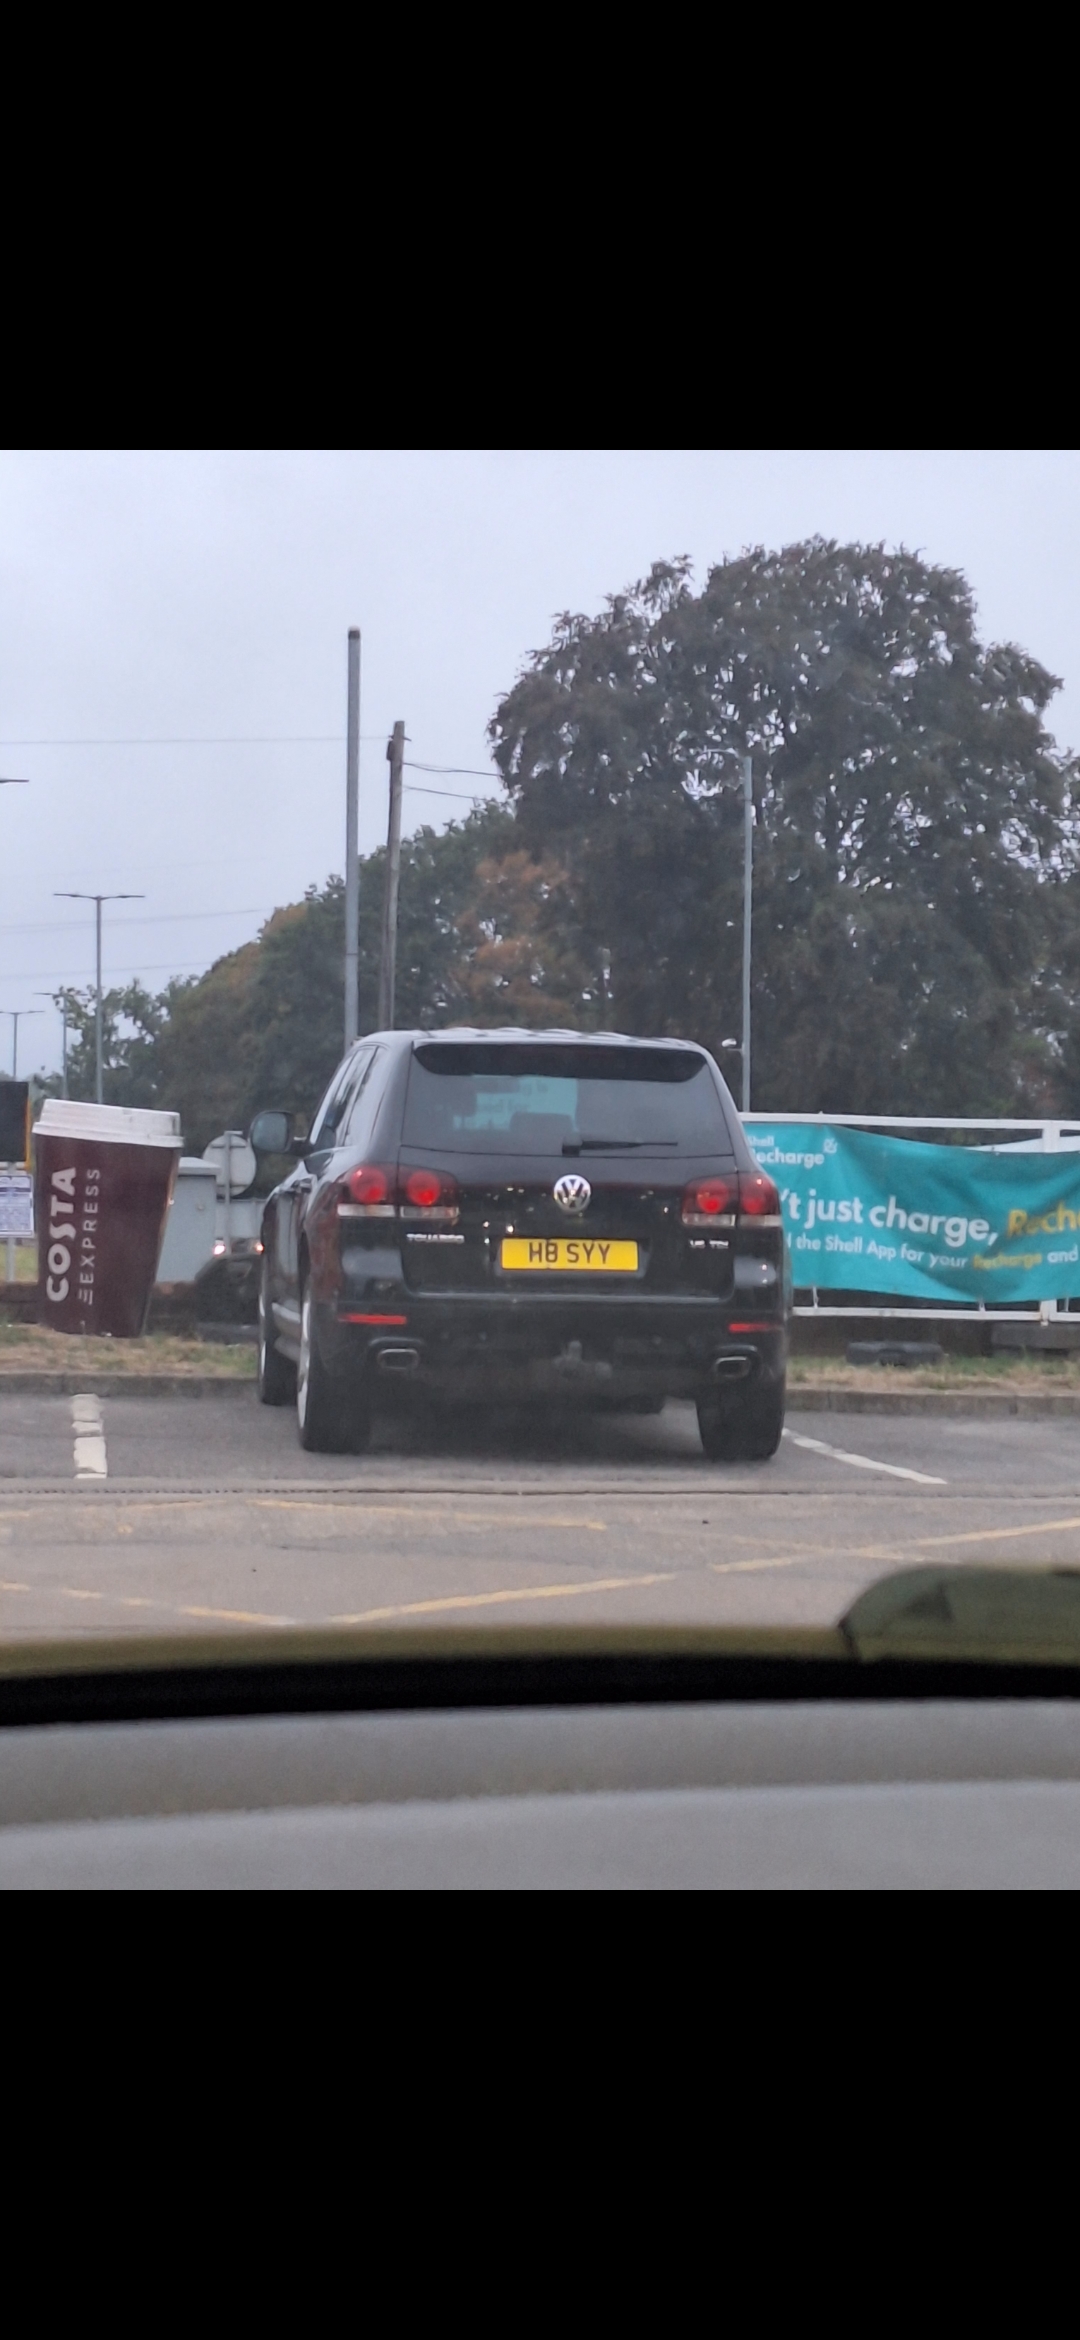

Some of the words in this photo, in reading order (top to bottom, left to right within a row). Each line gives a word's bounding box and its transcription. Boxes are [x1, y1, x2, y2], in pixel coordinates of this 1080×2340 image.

[752, 1147, 825, 1169] echarge
[46, 1166, 77, 1302] COSTA
[79, 1169, 100, 1285] EXPRESS
[804, 1188, 864, 1229] just
[869, 1195, 998, 1247] charge,
[566, 1243, 611, 1264] SYY
[796, 1232, 821, 1251] the
[825, 1234, 863, 1254] Shell
[866, 1239, 897, 1261] App
[901, 1243, 925, 1262] for
[929, 1251, 968, 1268] your
[1047, 1243, 1079, 1263] and
